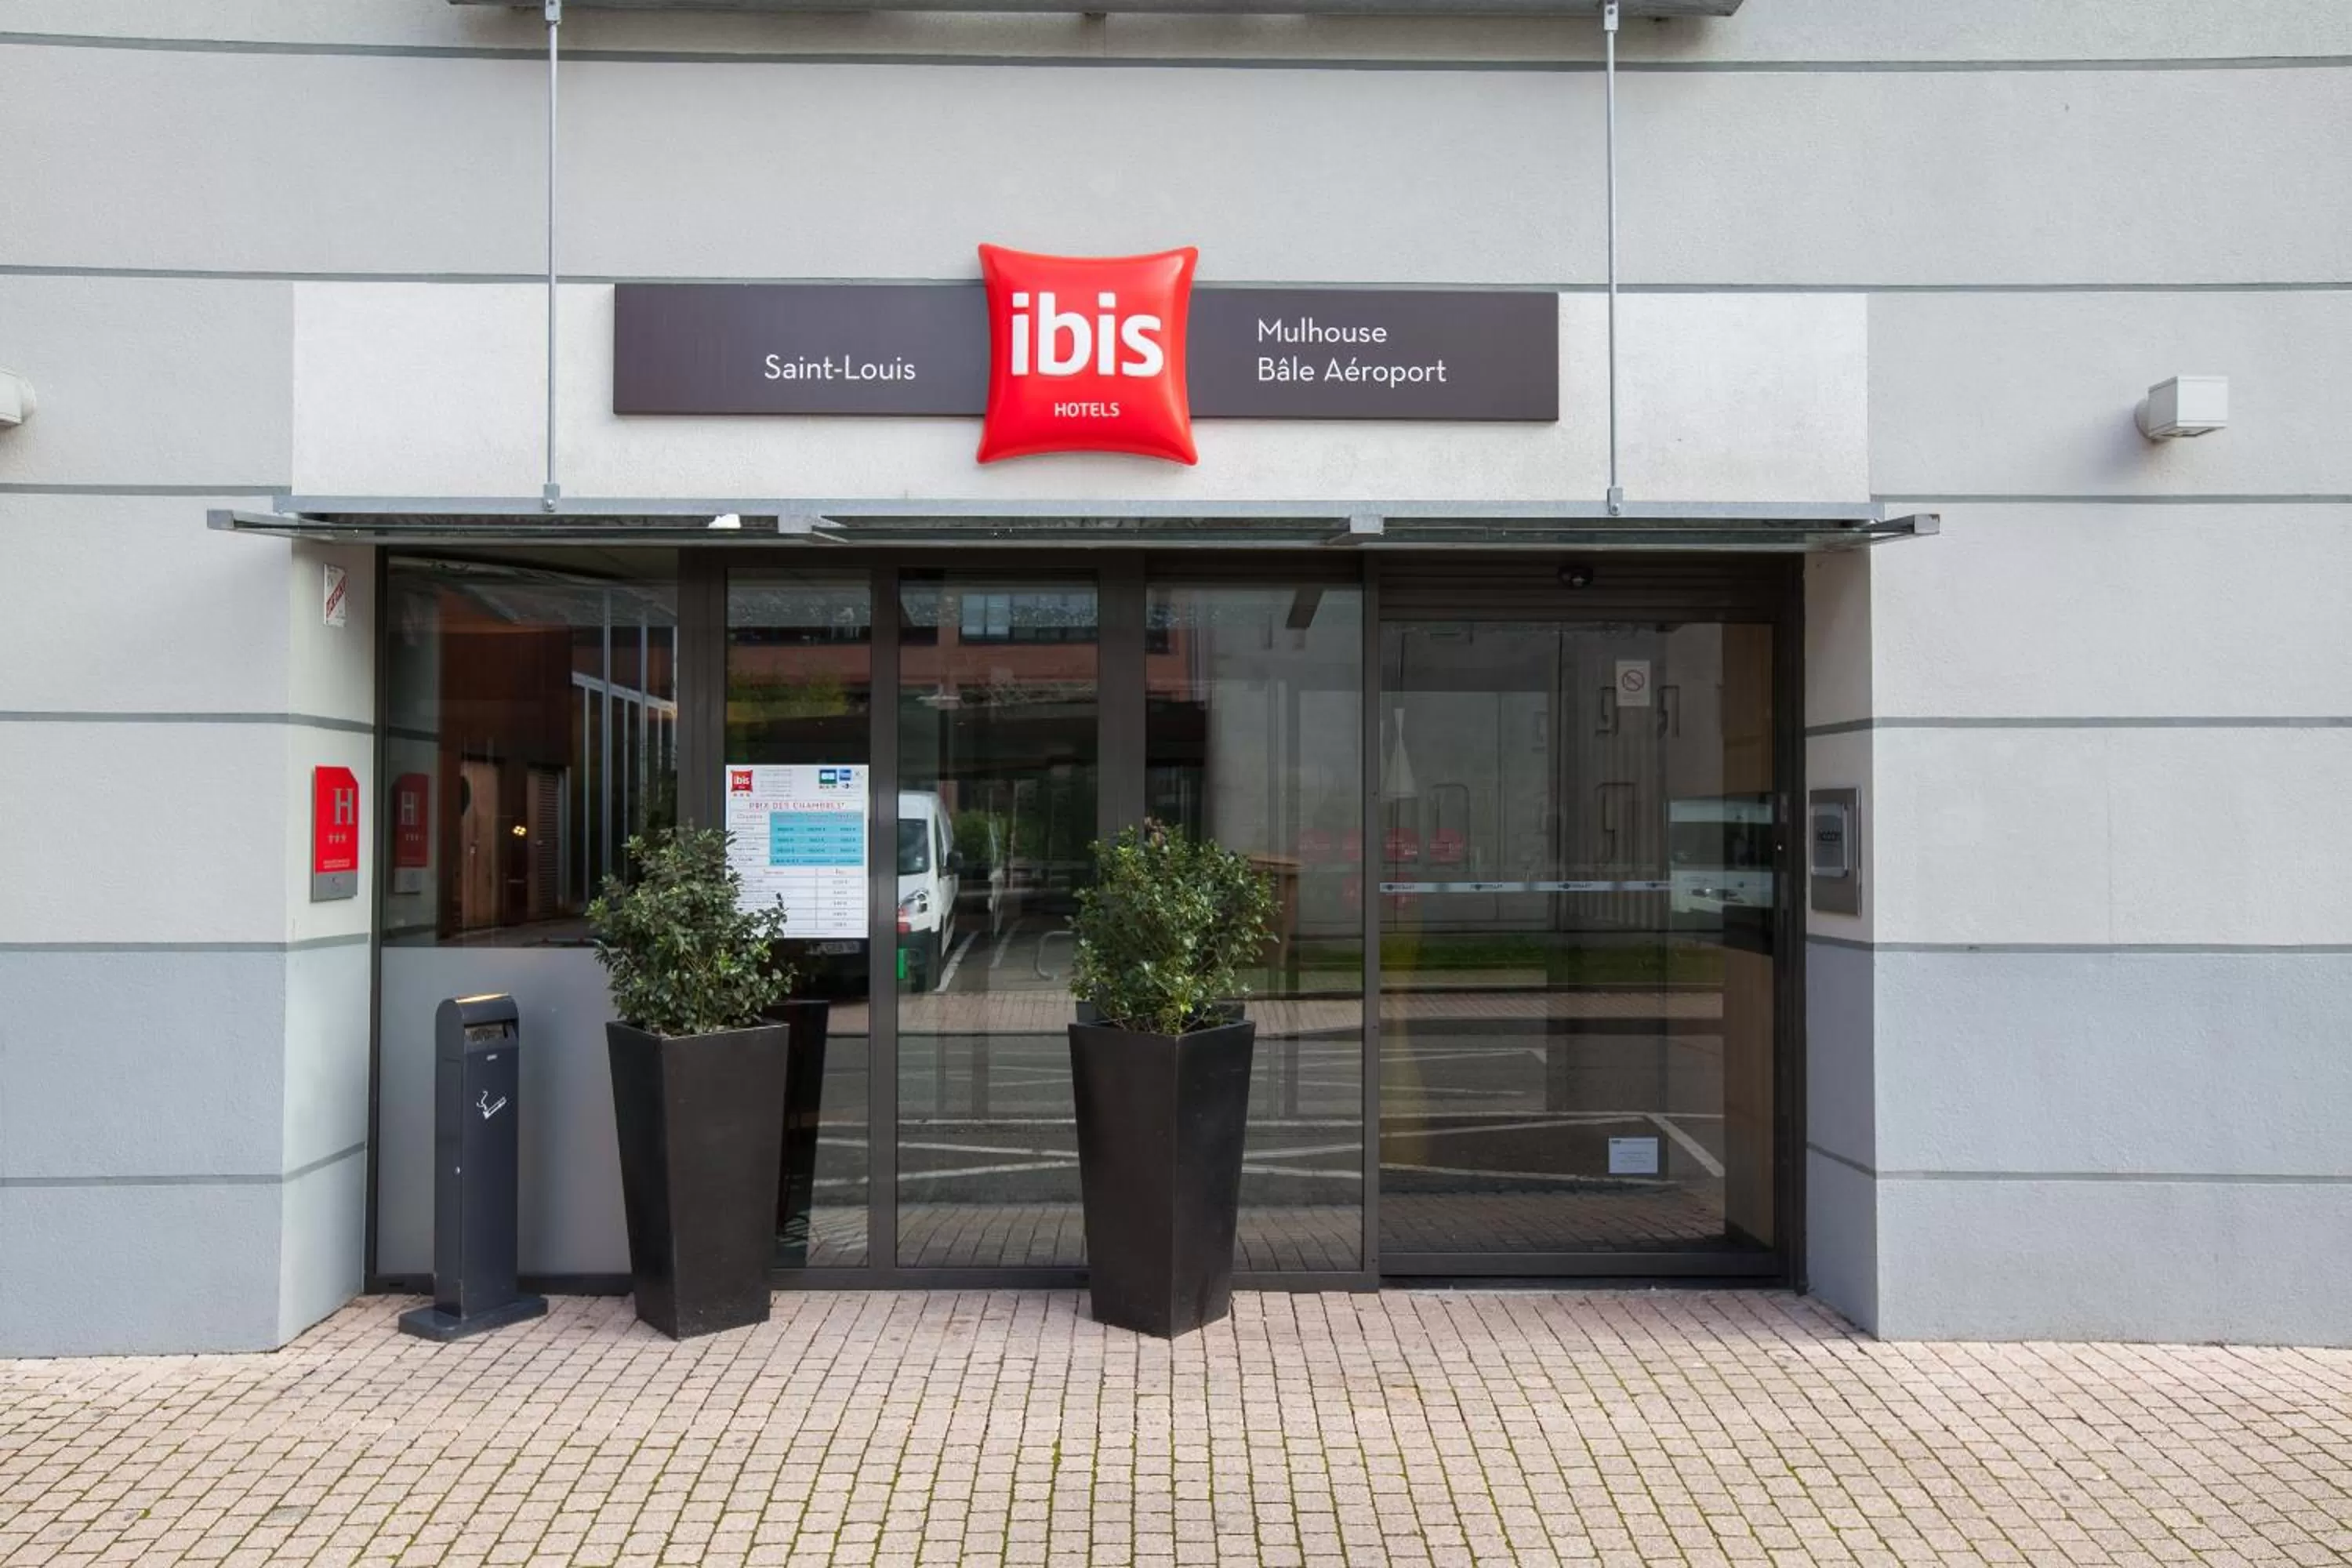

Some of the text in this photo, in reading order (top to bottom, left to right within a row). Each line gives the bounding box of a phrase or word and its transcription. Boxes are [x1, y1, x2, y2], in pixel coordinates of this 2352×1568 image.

[1012, 292, 1164, 377] ibis
[1258, 317, 1387, 343] Mulhouse
[764, 354, 916, 380] Saint-Louis
[1258, 355, 1447, 389] Bâle Aéroport
[1054, 402, 1120, 417] HOTELS
[733, 775, 750, 785] ibis
[333, 788, 354, 825] H
